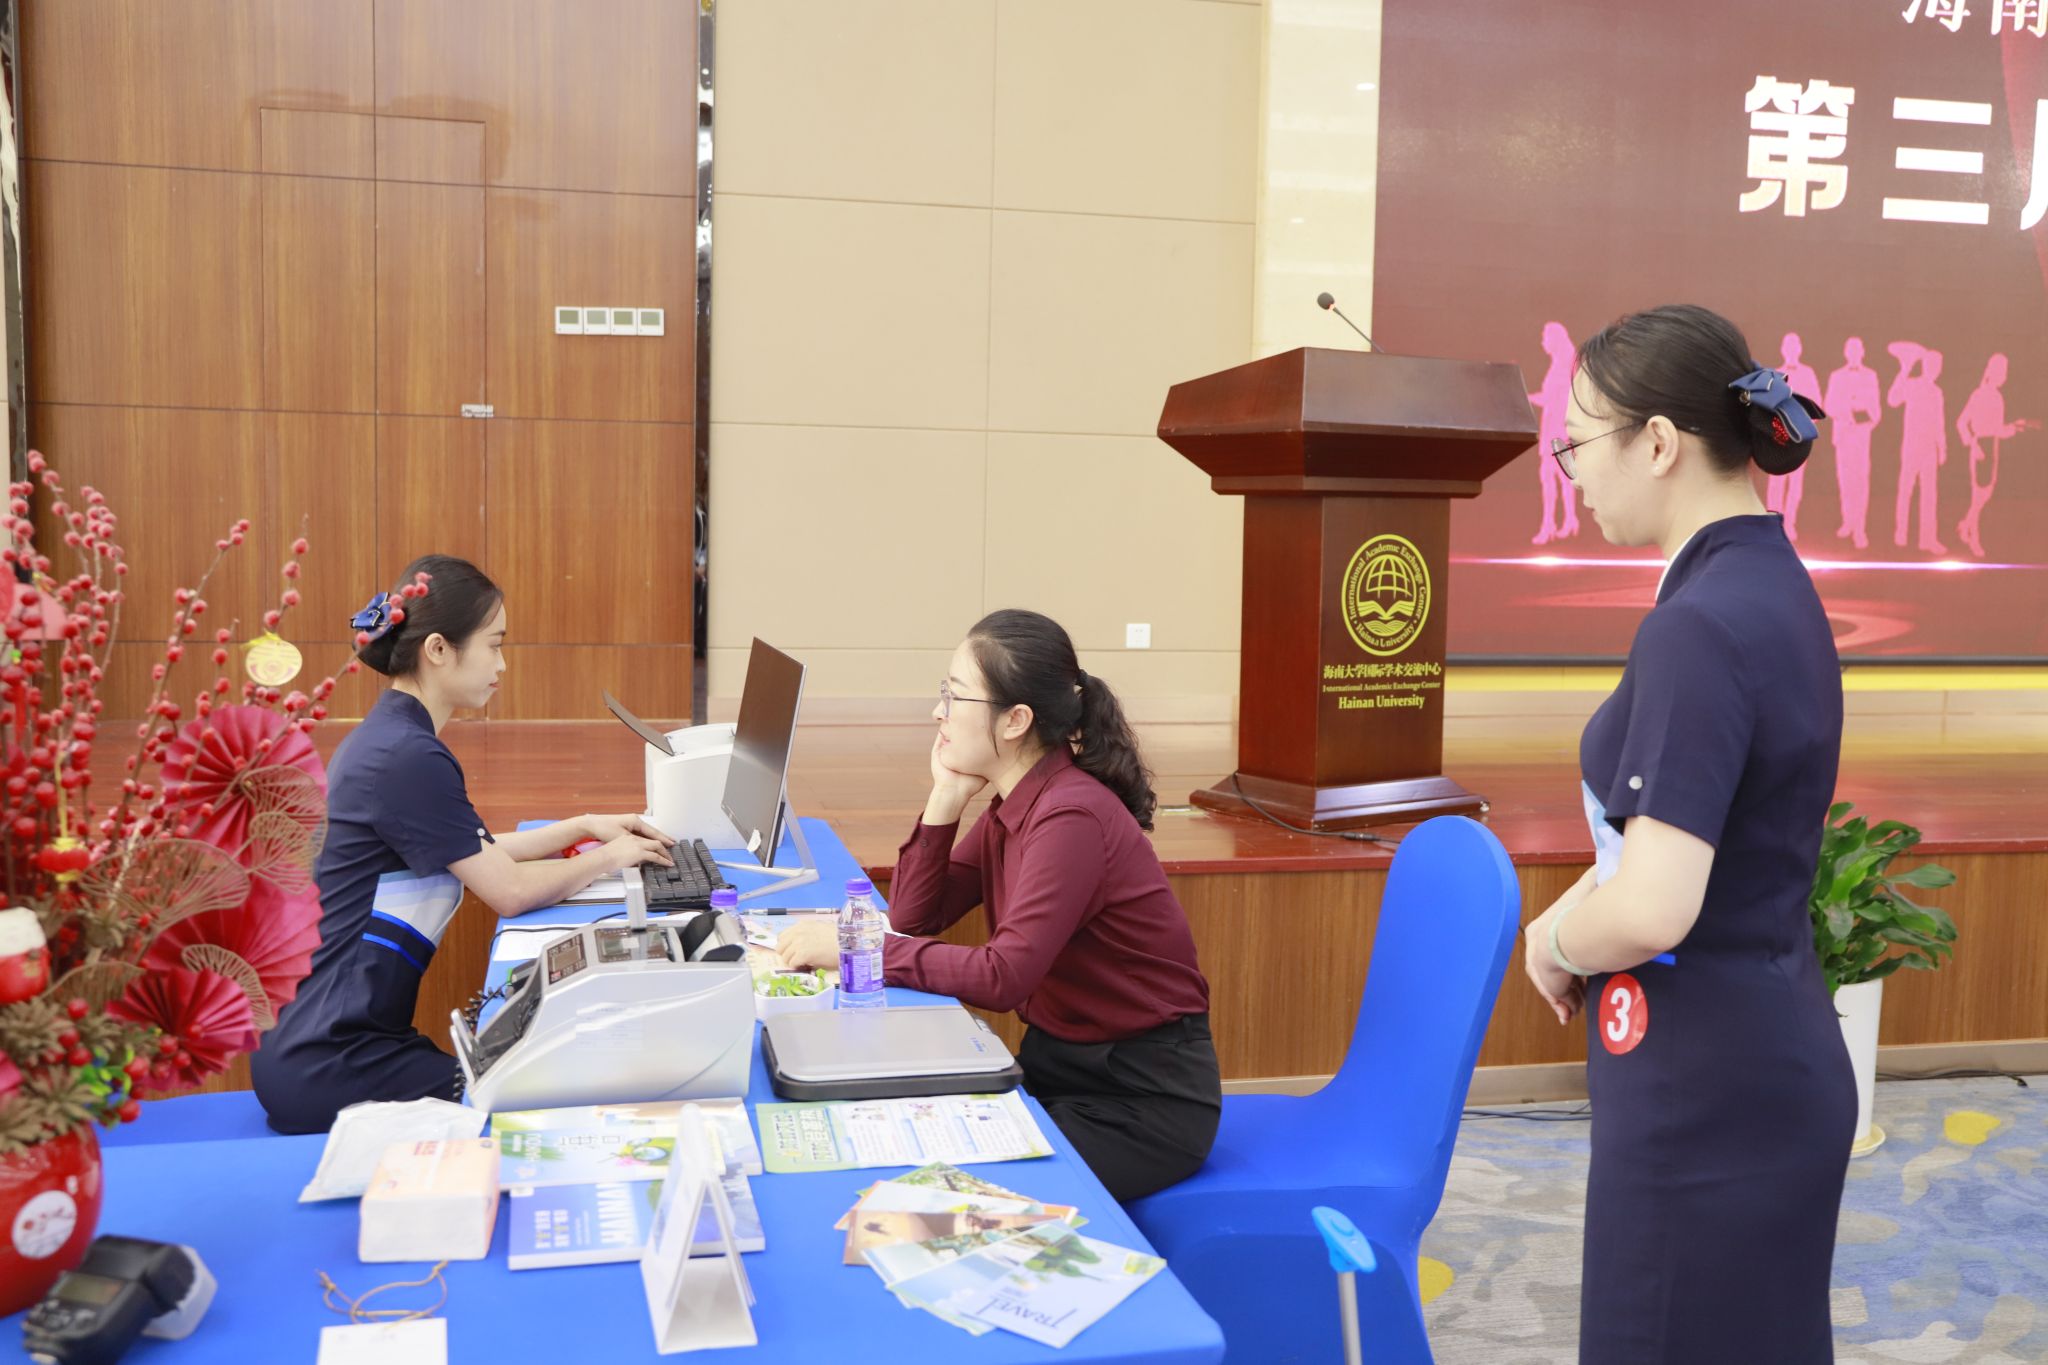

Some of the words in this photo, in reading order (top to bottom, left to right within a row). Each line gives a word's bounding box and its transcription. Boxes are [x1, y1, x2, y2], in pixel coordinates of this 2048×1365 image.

[1739, 75, 2048, 230] 第三
[1416, 586, 1426, 619] Center
[1323, 662, 1442, 679] 海南大学国际学术交流中心
[1323, 684, 1363, 693] International
[1363, 681, 1392, 691] Academic
[1393, 681, 1421, 692] Exchange
[1421, 681, 1441, 689] Center
[1338, 696, 1375, 709] Hainan
[1376, 694, 1425, 710] University
[1607, 987, 1632, 1042] 3
